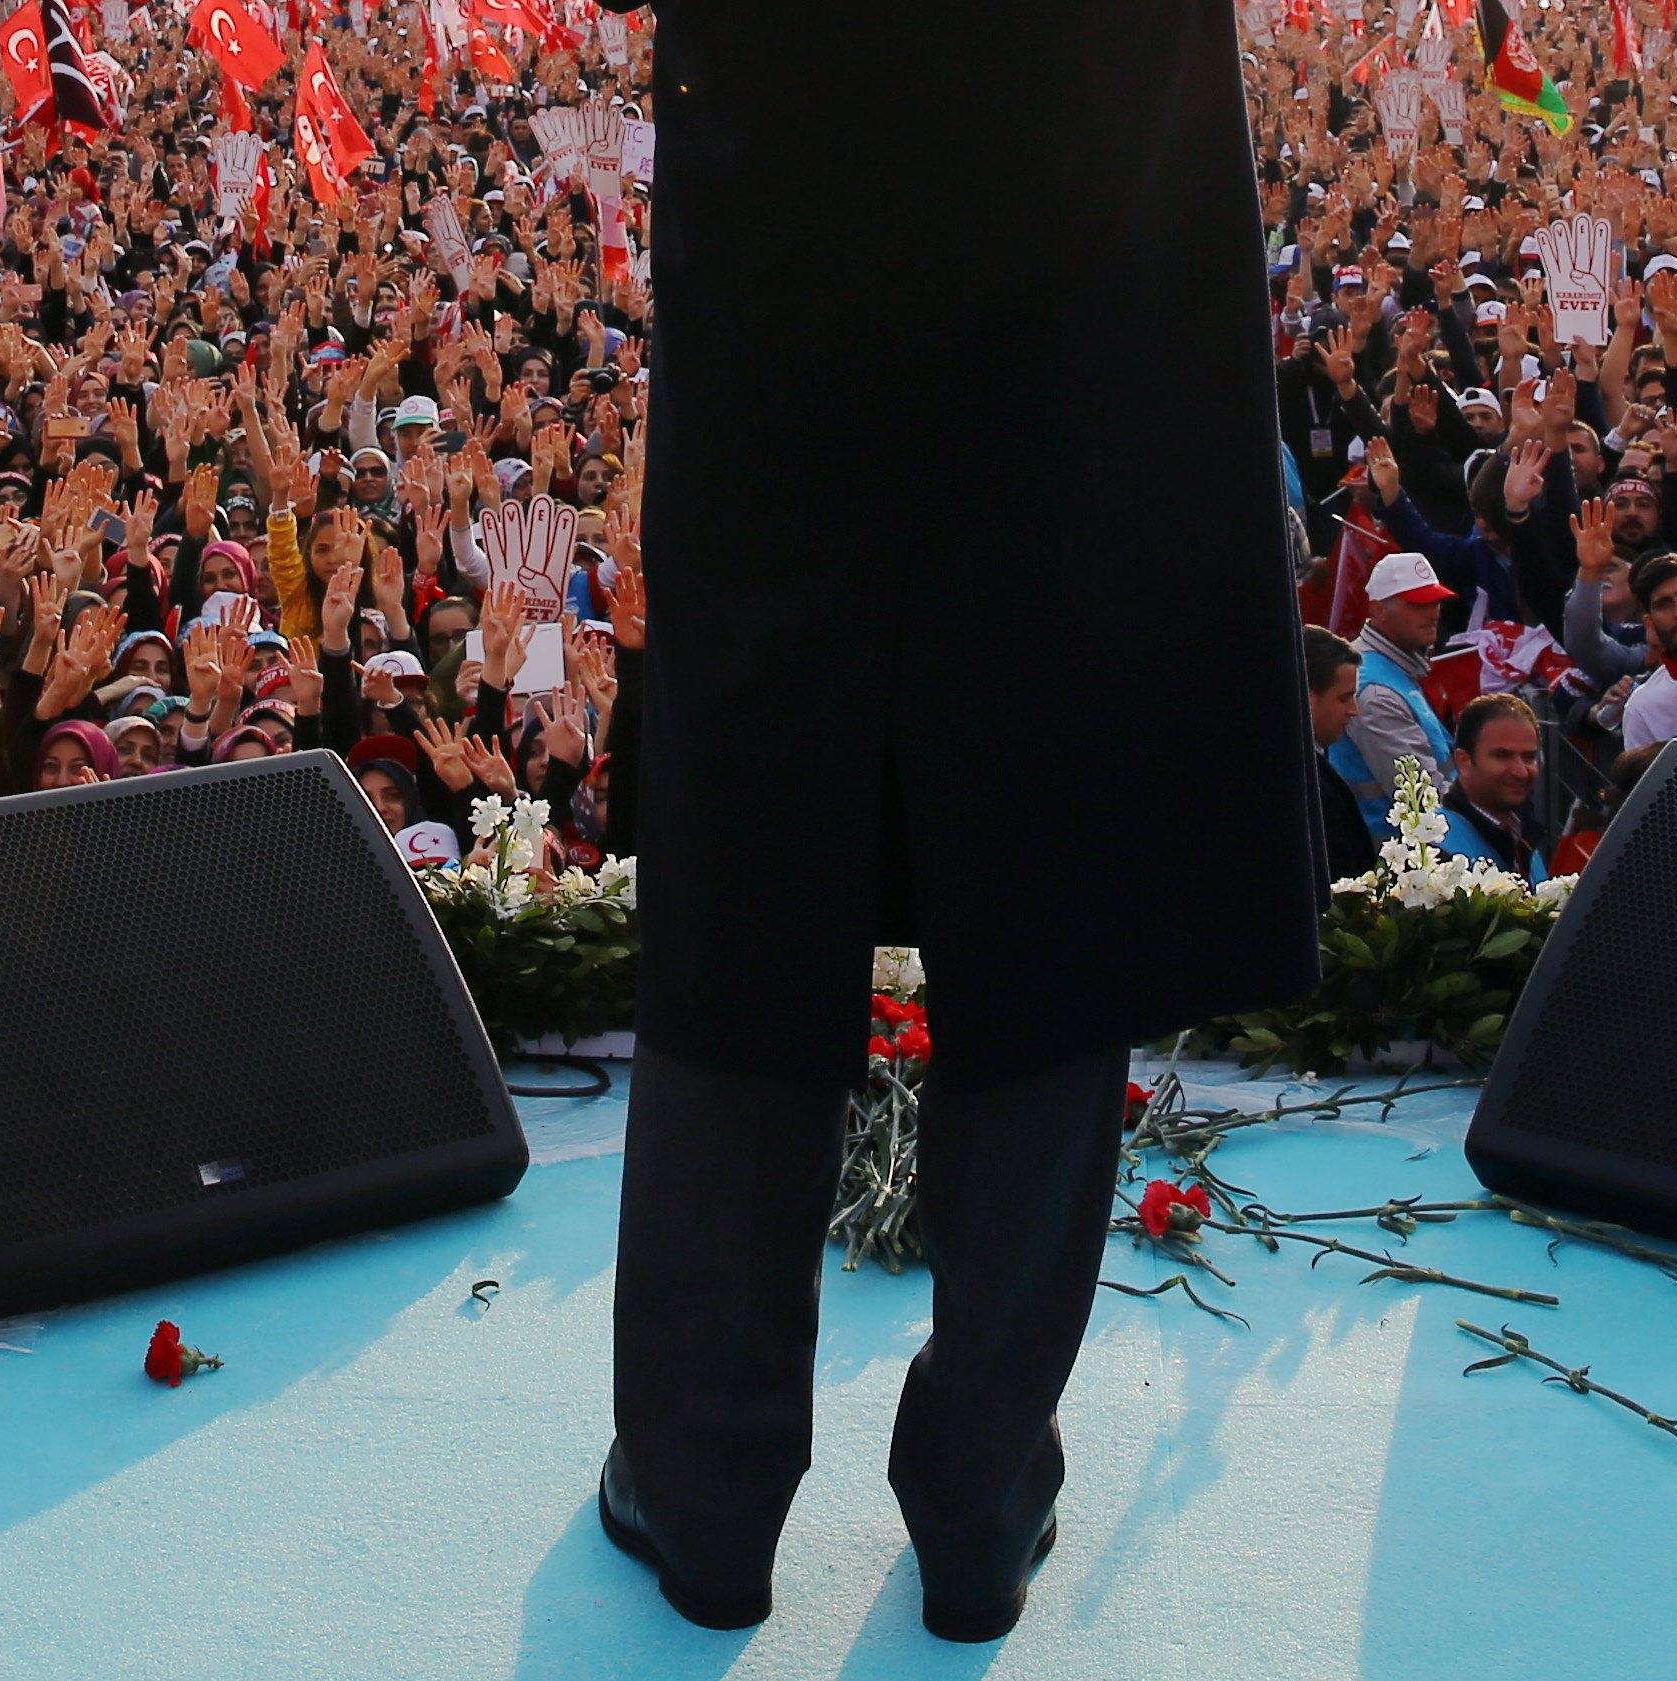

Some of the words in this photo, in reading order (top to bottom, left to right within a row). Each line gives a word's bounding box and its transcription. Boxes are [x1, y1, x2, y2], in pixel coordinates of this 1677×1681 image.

[590, 160, 618, 171] EVET
[1559, 300, 1601, 311] EVET
[521, 608, 556, 621] ET
